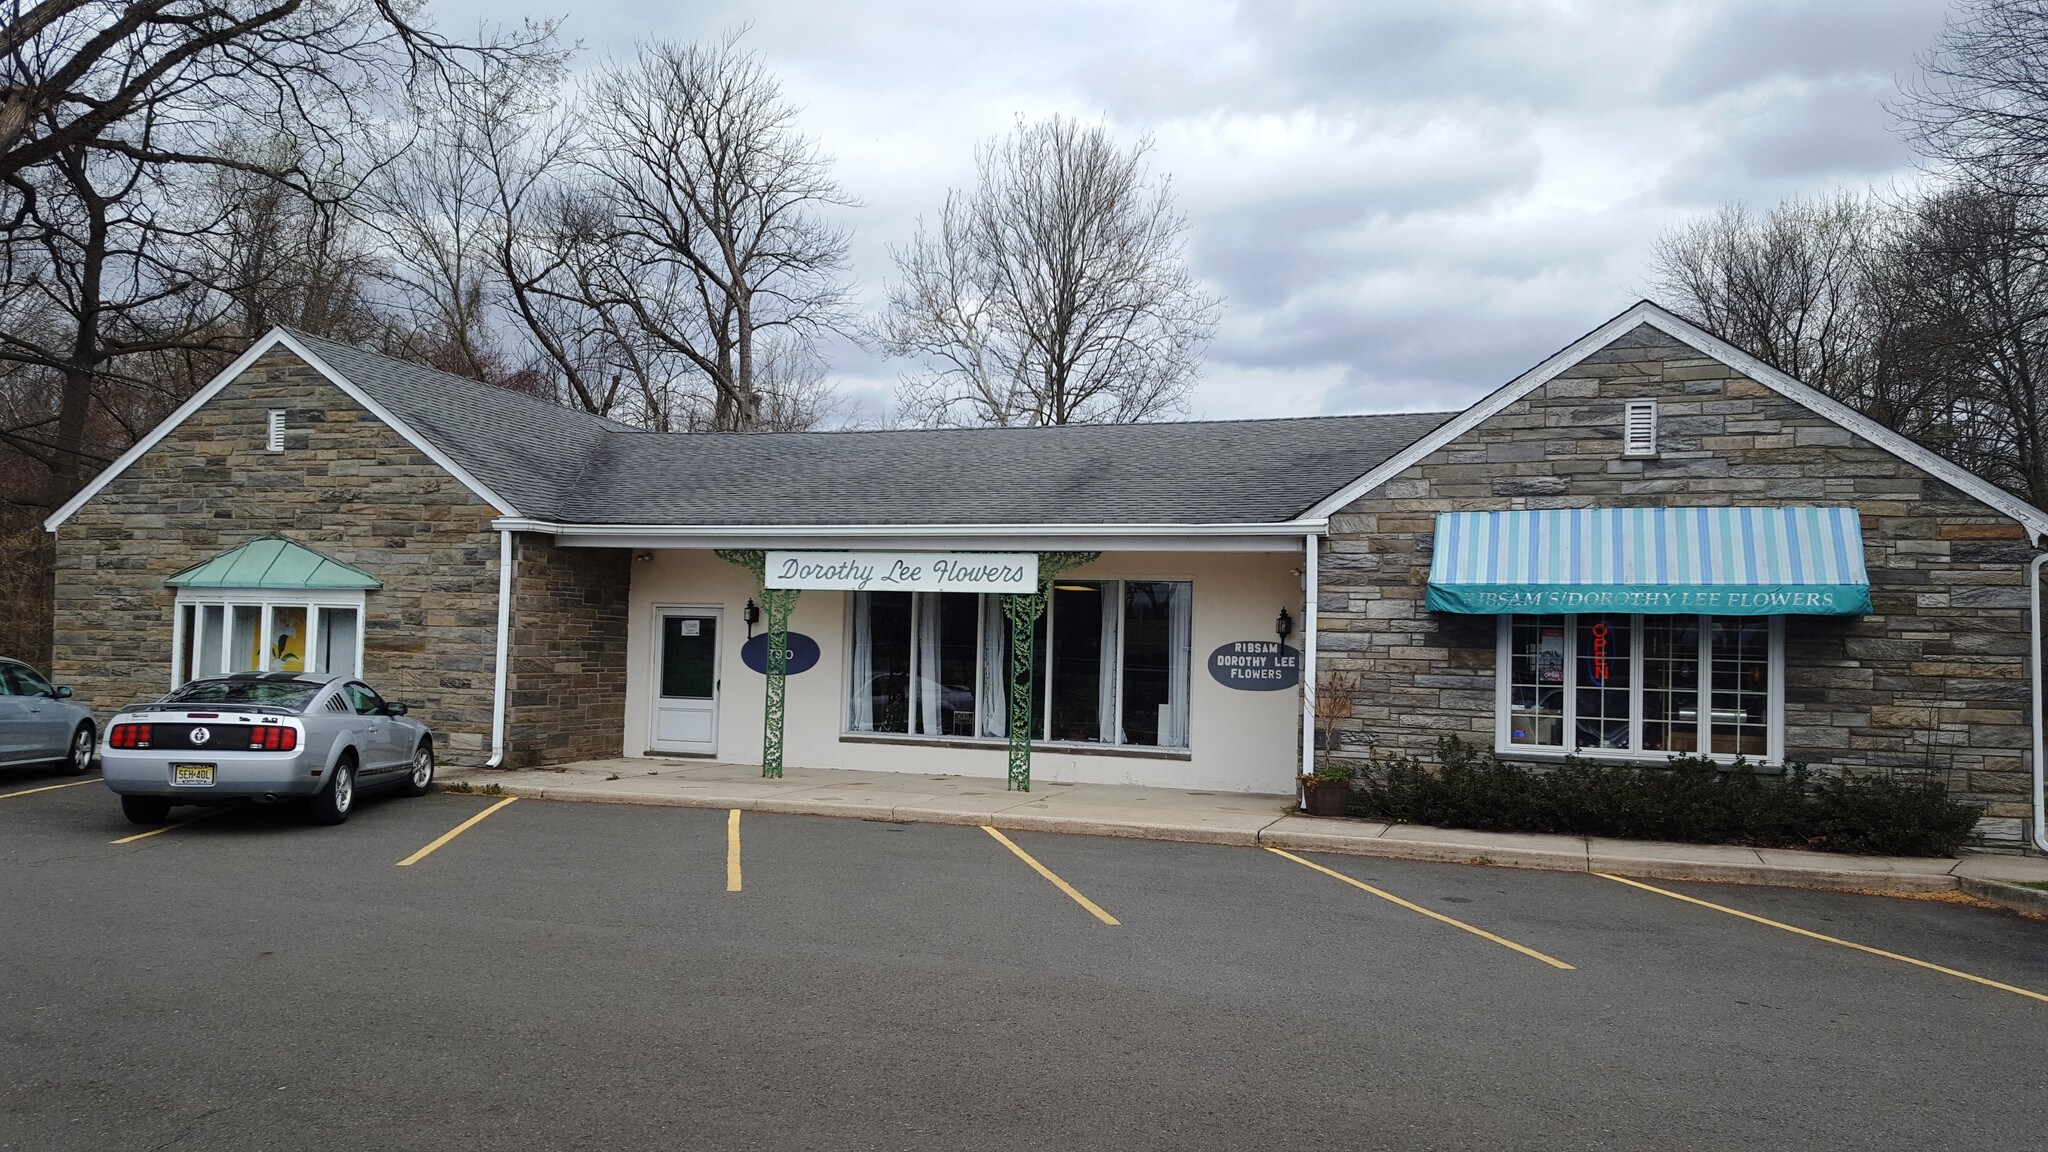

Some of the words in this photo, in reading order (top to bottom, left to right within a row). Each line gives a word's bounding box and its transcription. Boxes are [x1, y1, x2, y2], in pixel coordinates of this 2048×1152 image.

[778, 558, 873, 589] Dorothy
[881, 560, 922, 584] Lee
[933, 560, 1024, 583] Flowers
[1682, 592, 1721, 607] LEE
[1728, 592, 1833, 607] FLOWERS
[1235, 642, 1278, 653] RIBSAM
[1592, 623, 1609, 680] OPEN
[1217, 655, 1267, 667] DOROTHY
[1274, 656, 1295, 667] LEE
[1230, 668, 1282, 679] FLOWERS
